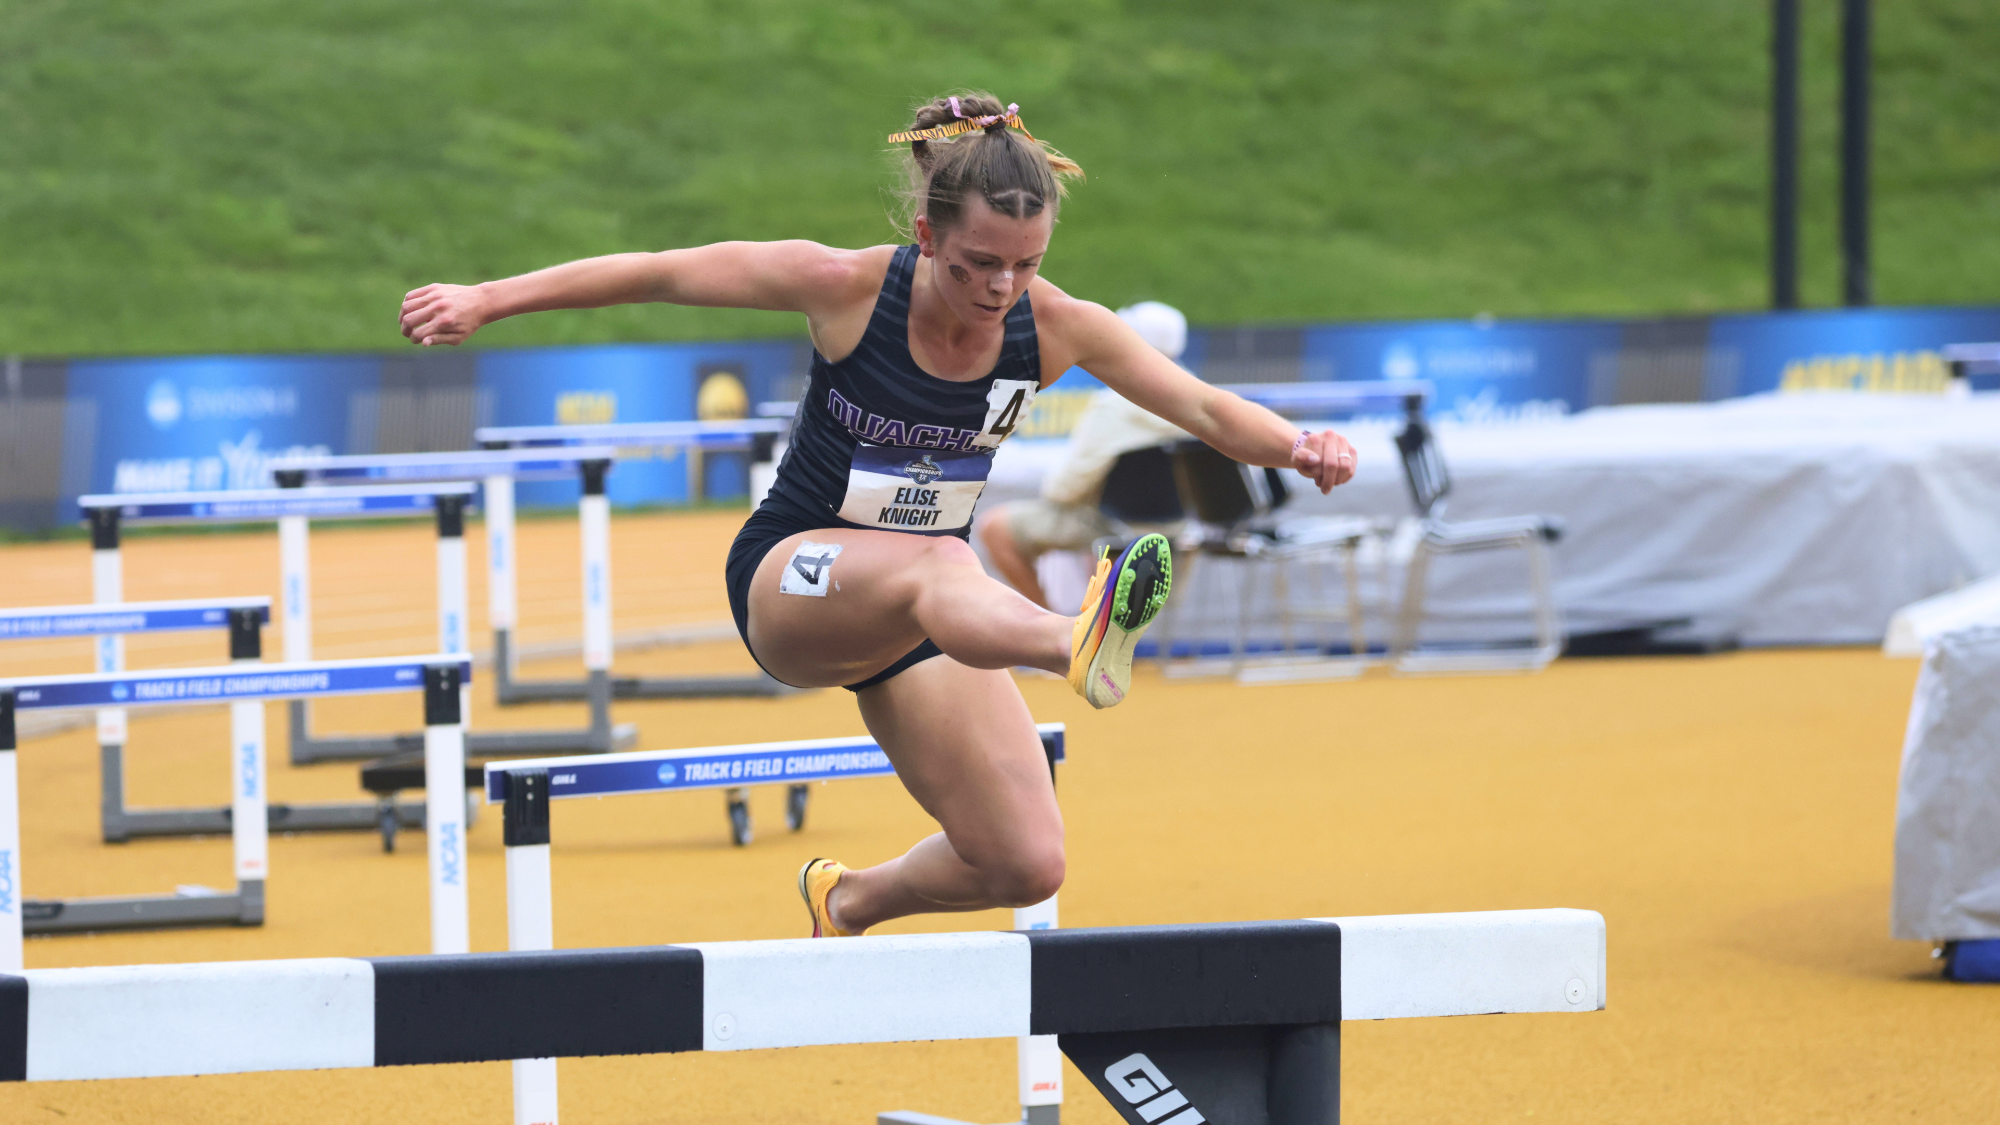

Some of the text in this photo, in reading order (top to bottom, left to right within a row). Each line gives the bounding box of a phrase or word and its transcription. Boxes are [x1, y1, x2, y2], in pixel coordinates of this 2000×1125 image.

[988, 389, 1026, 444] 4
[894, 487, 940, 506] ELISE
[878, 507, 942, 525] KNIGHT
[792, 552, 834, 585] 4
[135, 680, 174, 699] TRACK
[187, 677, 222, 697] FIELD
[224, 671, 329, 695] CHAMPIONSHIPS
[684, 762, 730, 781] TRACK
[731, 760, 743, 778] &
[744, 757, 783, 777] FIELD
[440, 823, 458, 886] NCAA
